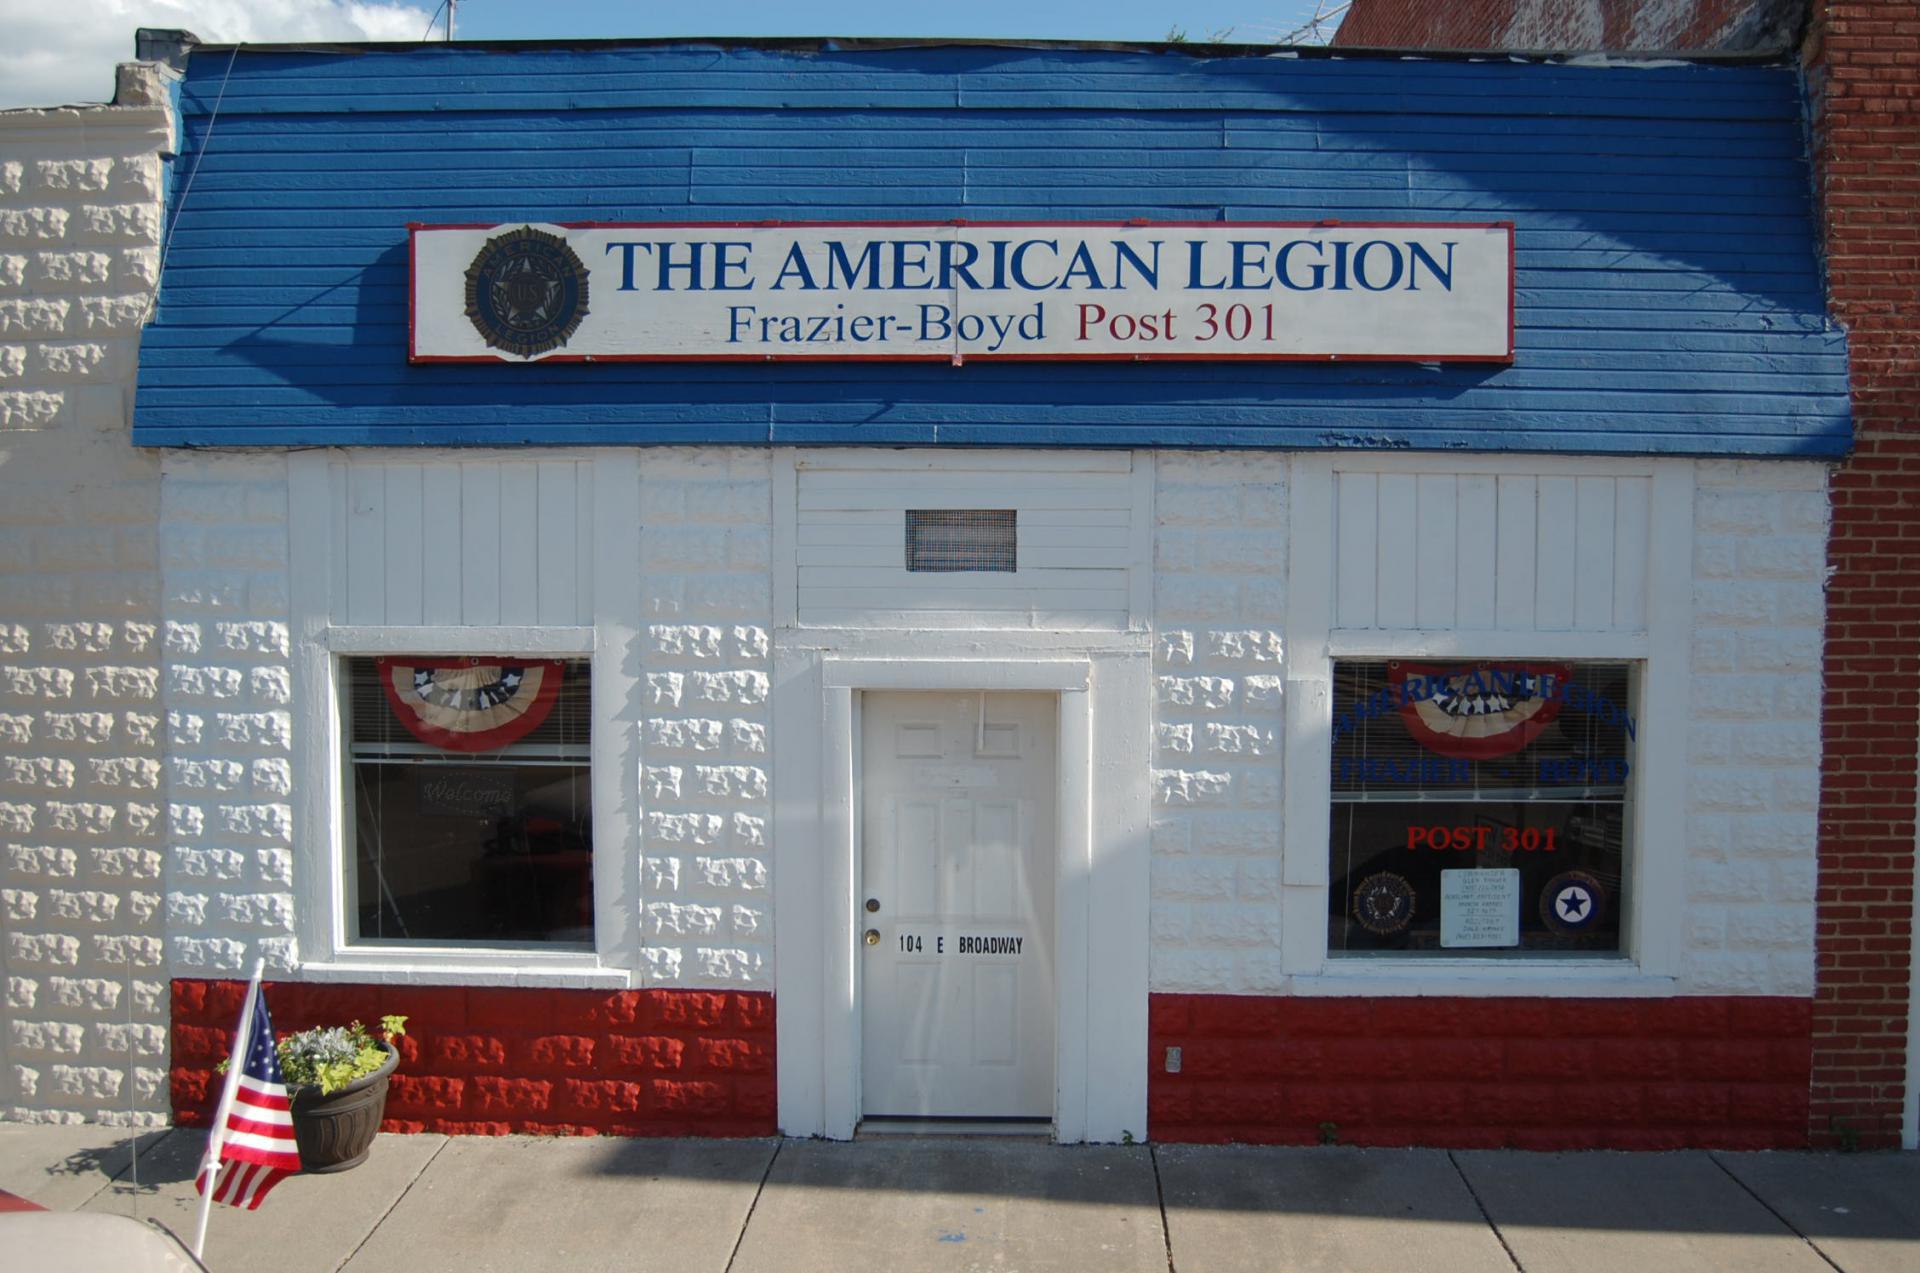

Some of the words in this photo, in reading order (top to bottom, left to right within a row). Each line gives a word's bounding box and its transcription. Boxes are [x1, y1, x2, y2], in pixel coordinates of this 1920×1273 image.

[482, 240, 574, 279] AMERICAN
[606, 240, 754, 292] THE
[769, 239, 1162, 292] AMERICAN
[1184, 239, 1457, 292] LEGION
[495, 322, 561, 344] LEGION
[728, 303, 1046, 352] Frazier-Boyd
[1074, 303, 1178, 341] Post
[1194, 303, 1277, 341] 301
[1331, 670, 1514, 744] AMERICAN
[1519, 671, 1636, 742] LEGION
[1406, 826, 1492, 851] POST
[1502, 827, 1558, 852] 301
[900, 935, 923, 953] 104
[937, 936, 944, 954] E
[959, 936, 1023, 954] BROADWAY
